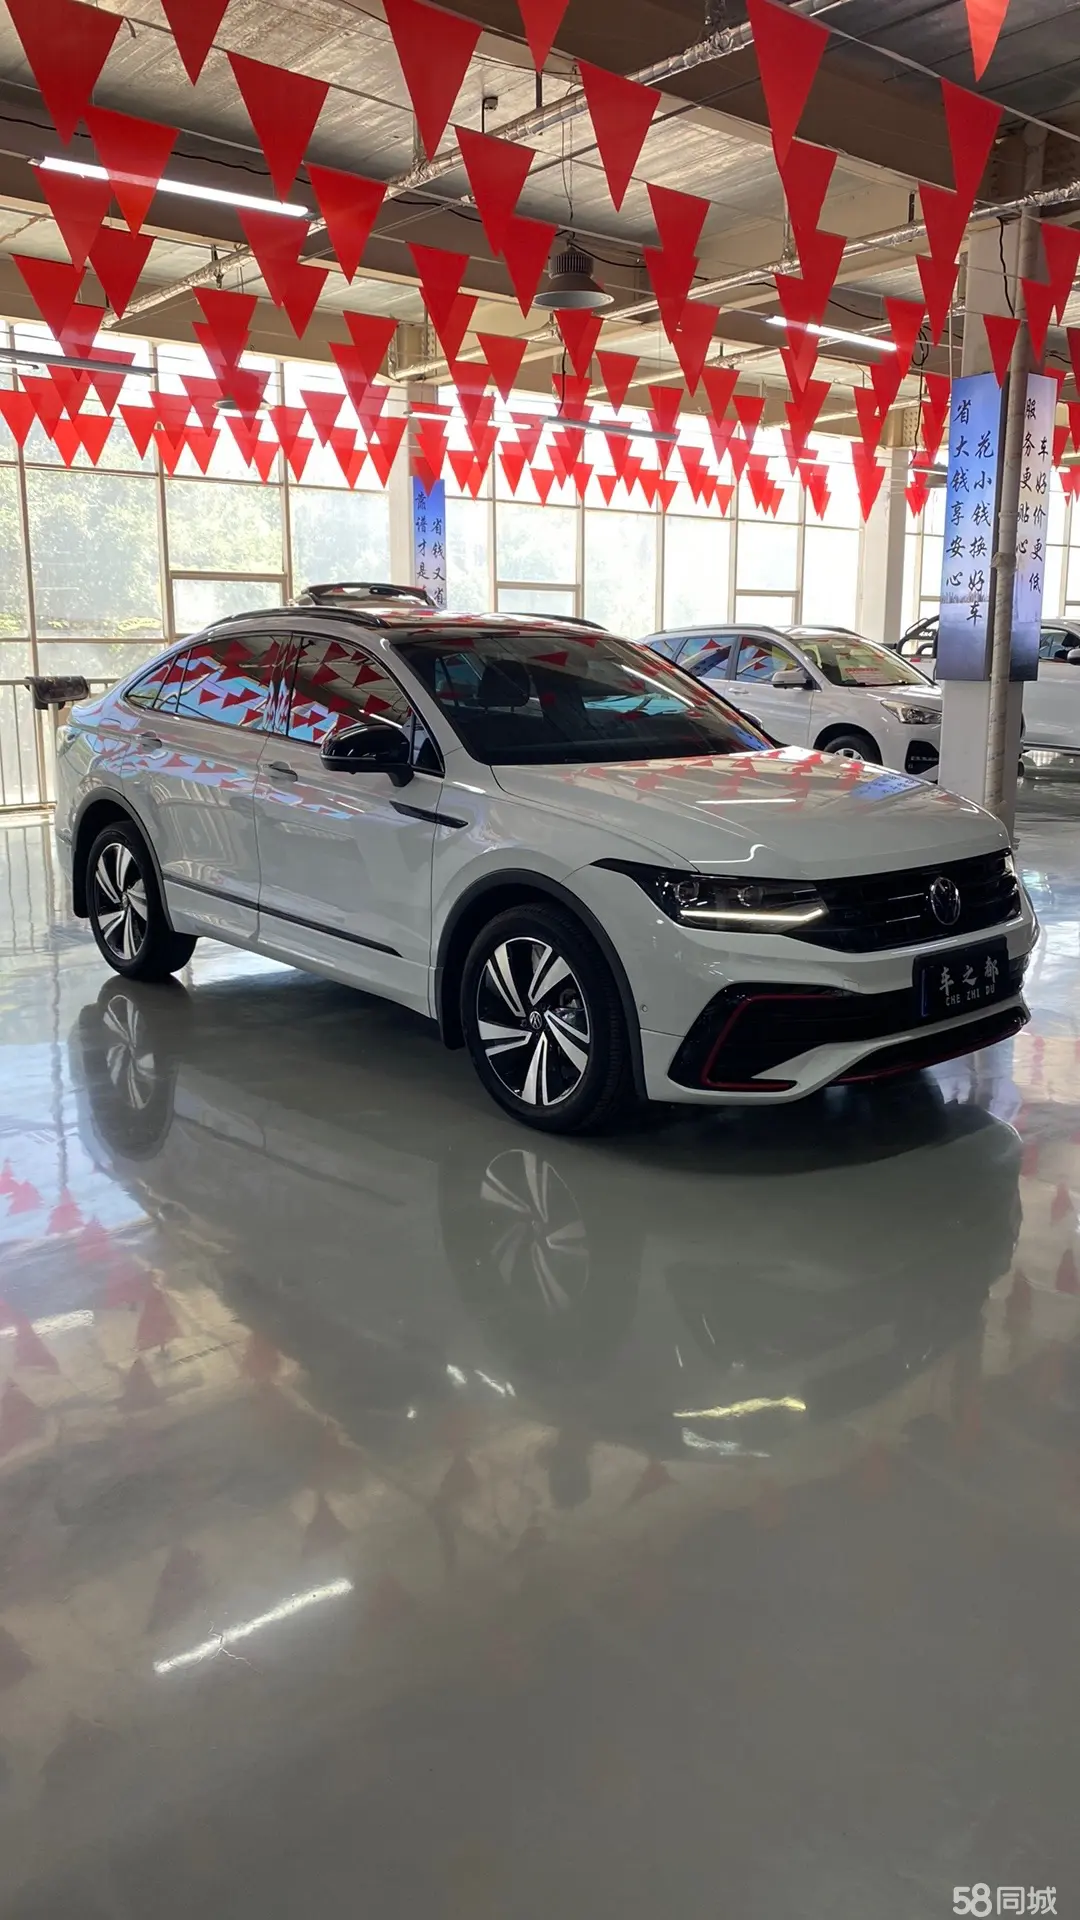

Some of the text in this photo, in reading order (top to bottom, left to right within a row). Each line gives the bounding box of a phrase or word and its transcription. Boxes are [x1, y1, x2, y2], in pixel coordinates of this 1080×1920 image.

[415, 491, 429, 588] 靠谱才是
[946, 400, 971, 587] 省大钱享安心
[966, 431, 994, 627] 花小钱换好车
[1016, 398, 1036, 555] 服务更贴心
[1028, 437, 1049, 594] 车好价更低
[939, 956, 999, 996] 车之都
[945, 984, 995, 1006] CHE ZHI DU
